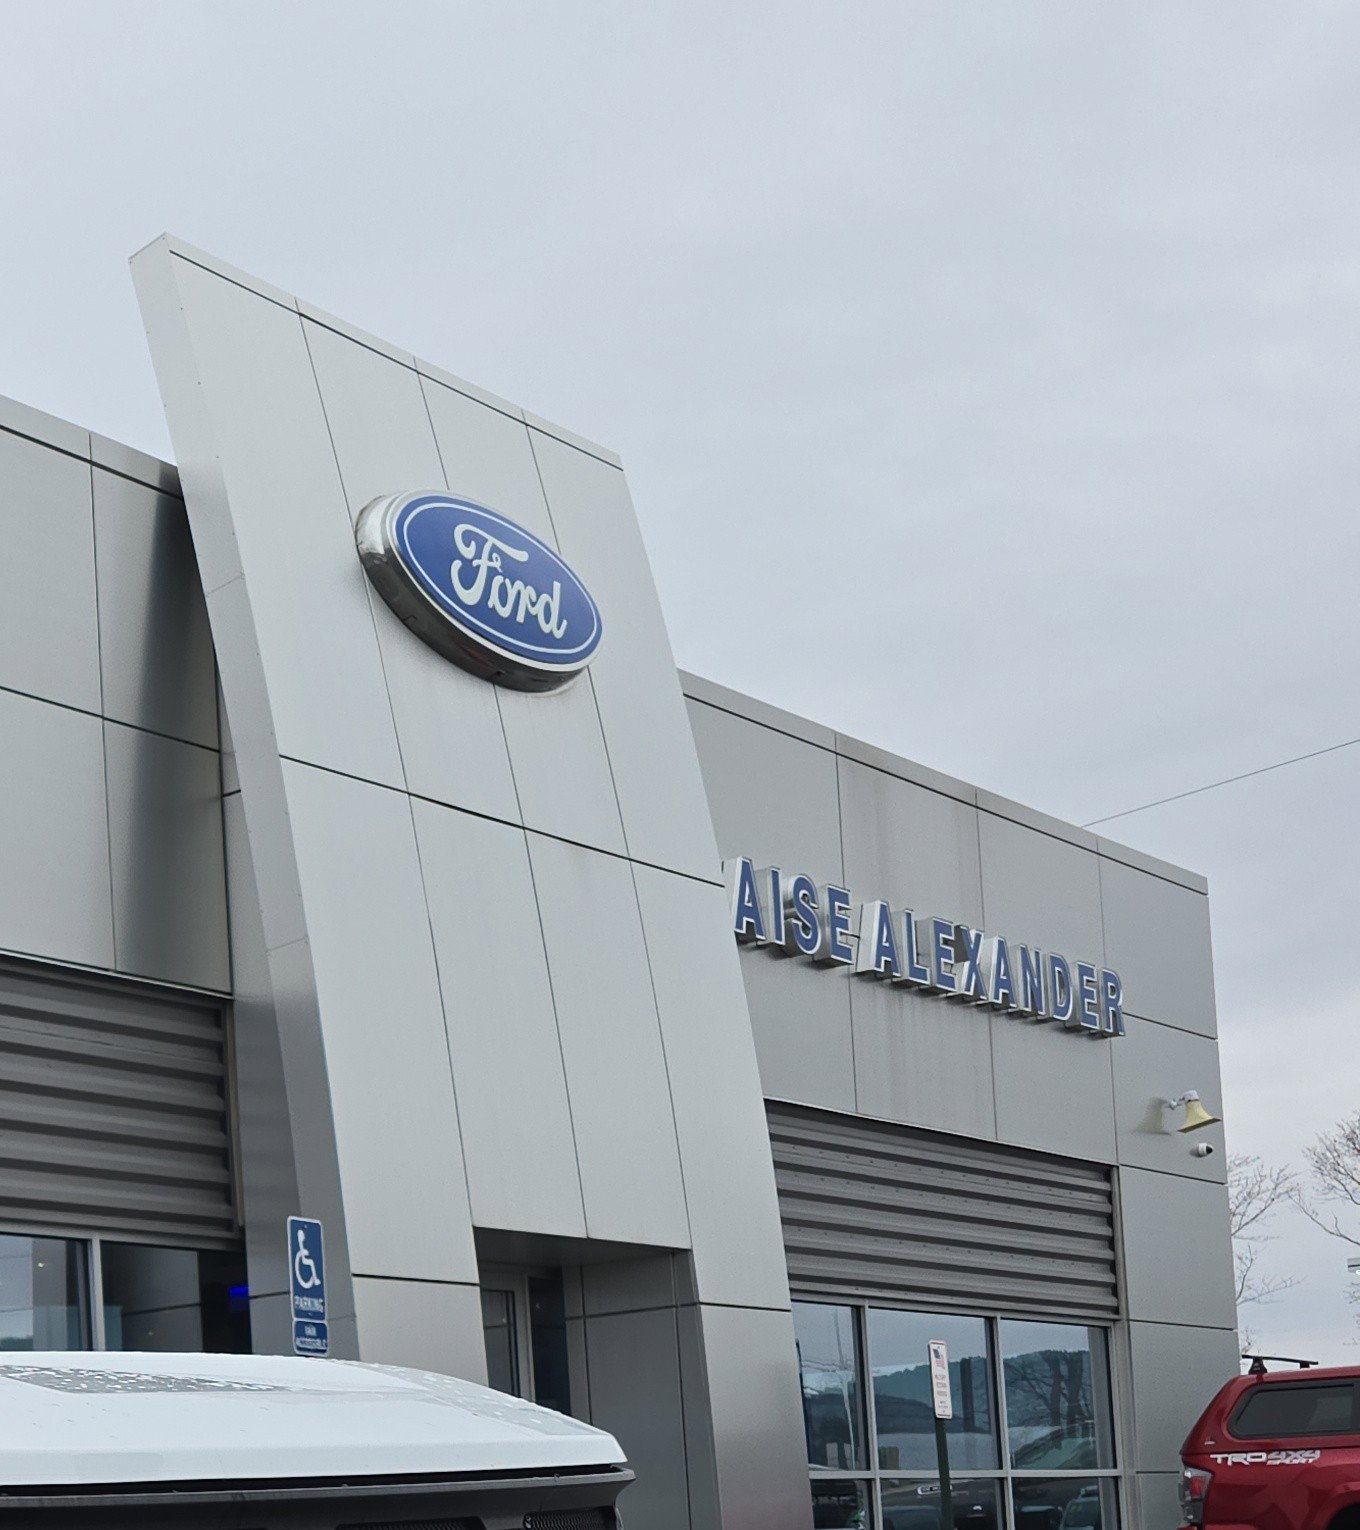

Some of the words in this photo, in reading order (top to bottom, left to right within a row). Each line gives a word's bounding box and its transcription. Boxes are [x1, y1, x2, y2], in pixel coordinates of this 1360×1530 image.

[450, 523, 568, 639] Ford
[735, 856, 854, 966] AISE
[868, 900, 1126, 1038] ALEXANDER
